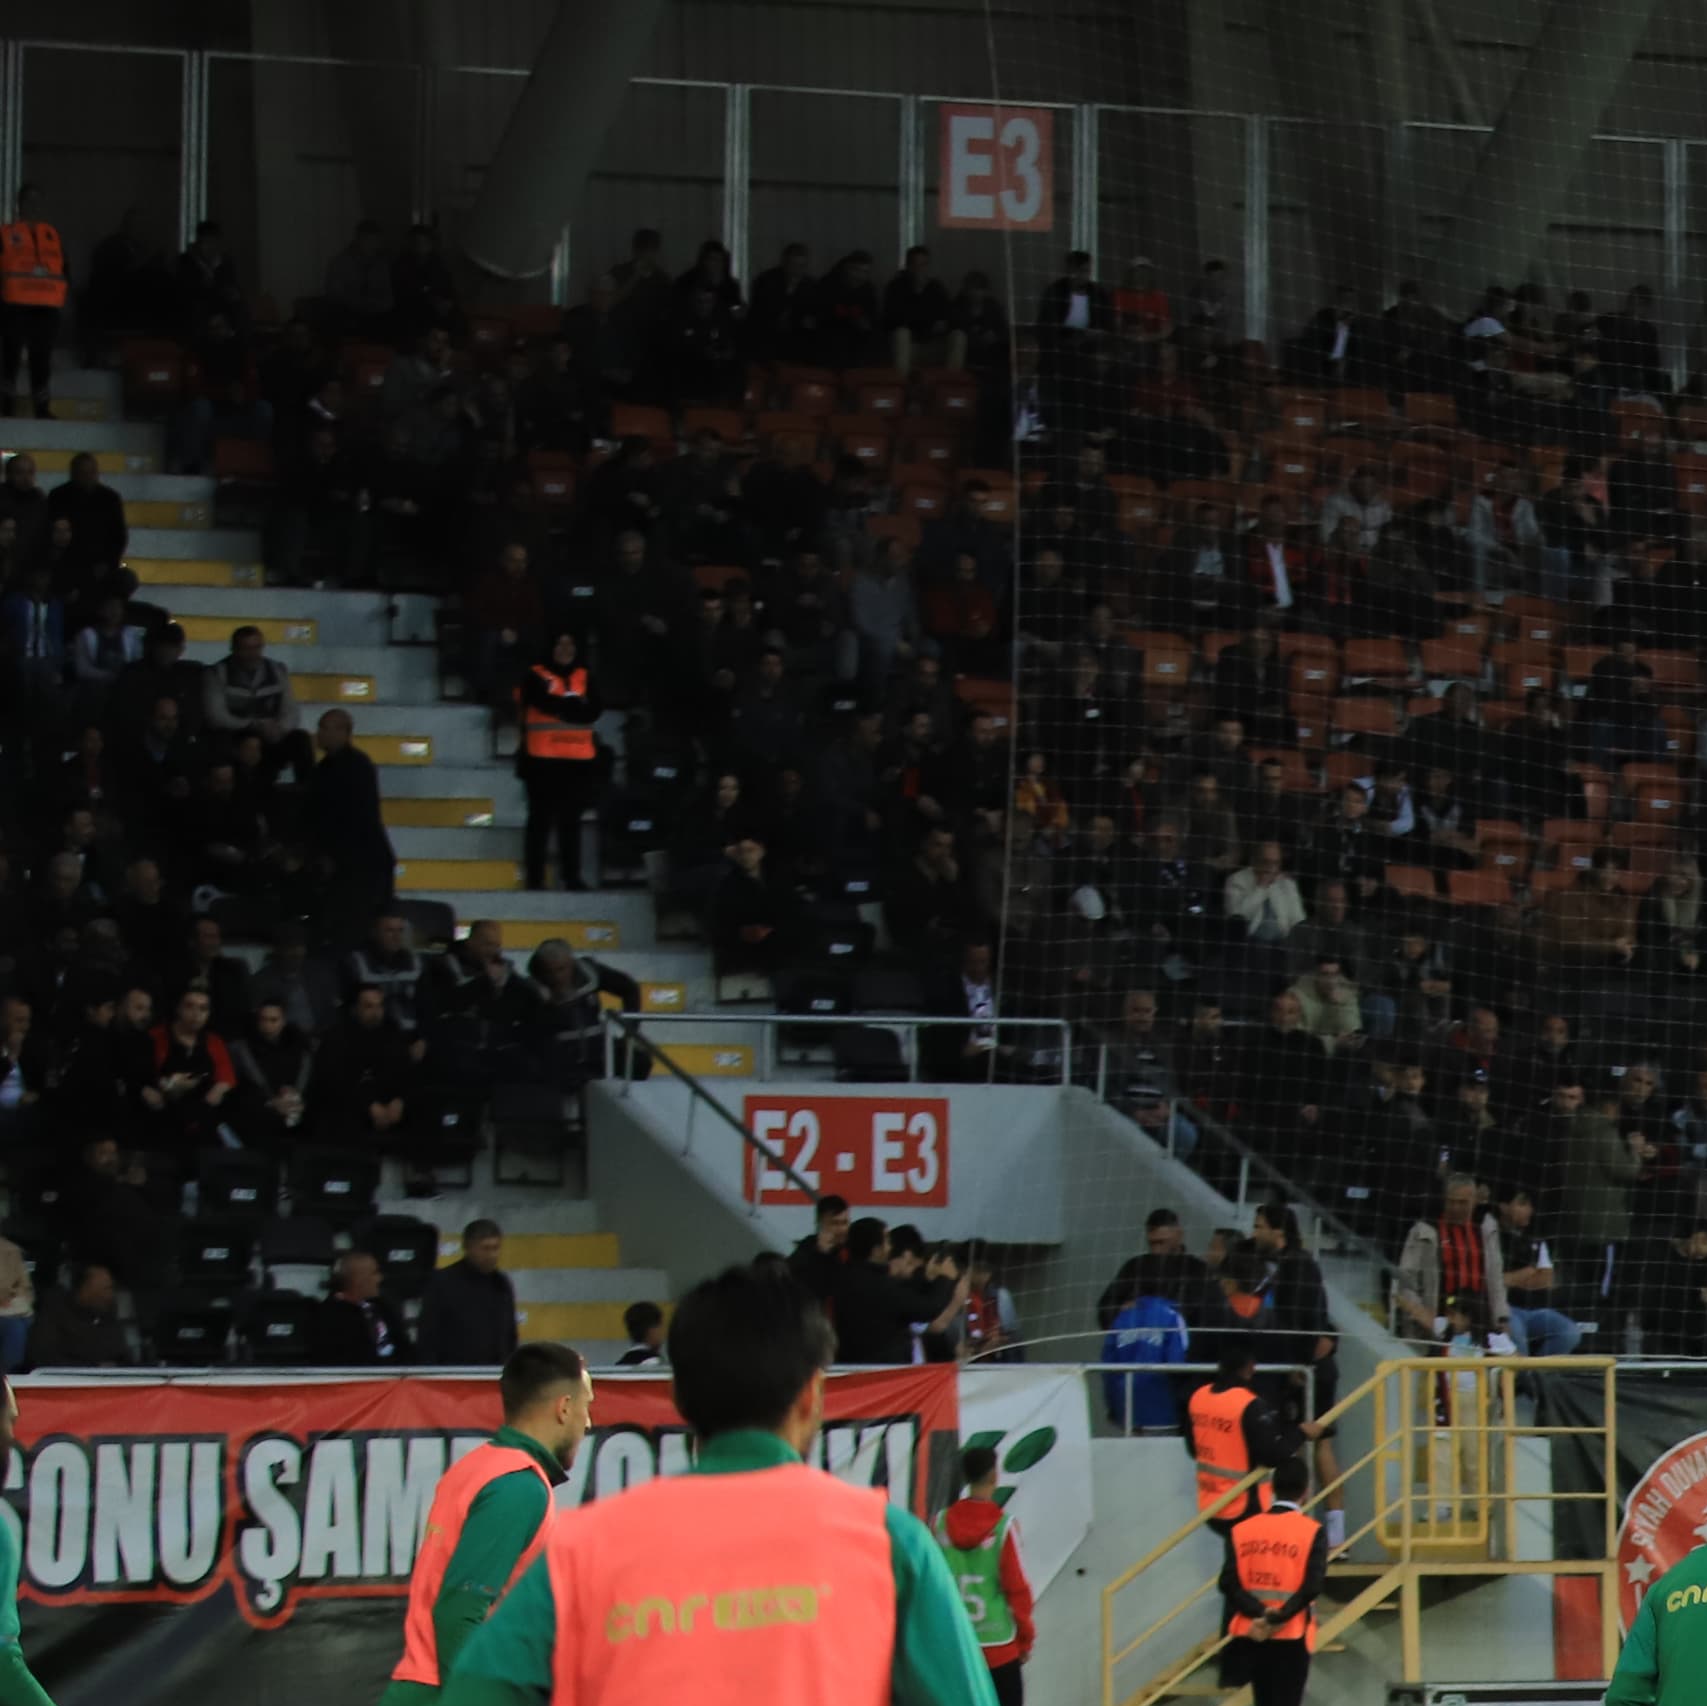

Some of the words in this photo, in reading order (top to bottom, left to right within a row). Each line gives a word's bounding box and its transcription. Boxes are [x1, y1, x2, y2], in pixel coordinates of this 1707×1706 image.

[951, 115, 1043, 222] E3
[753, 1109, 820, 1192] E2
[872, 1111, 939, 1194] E3
